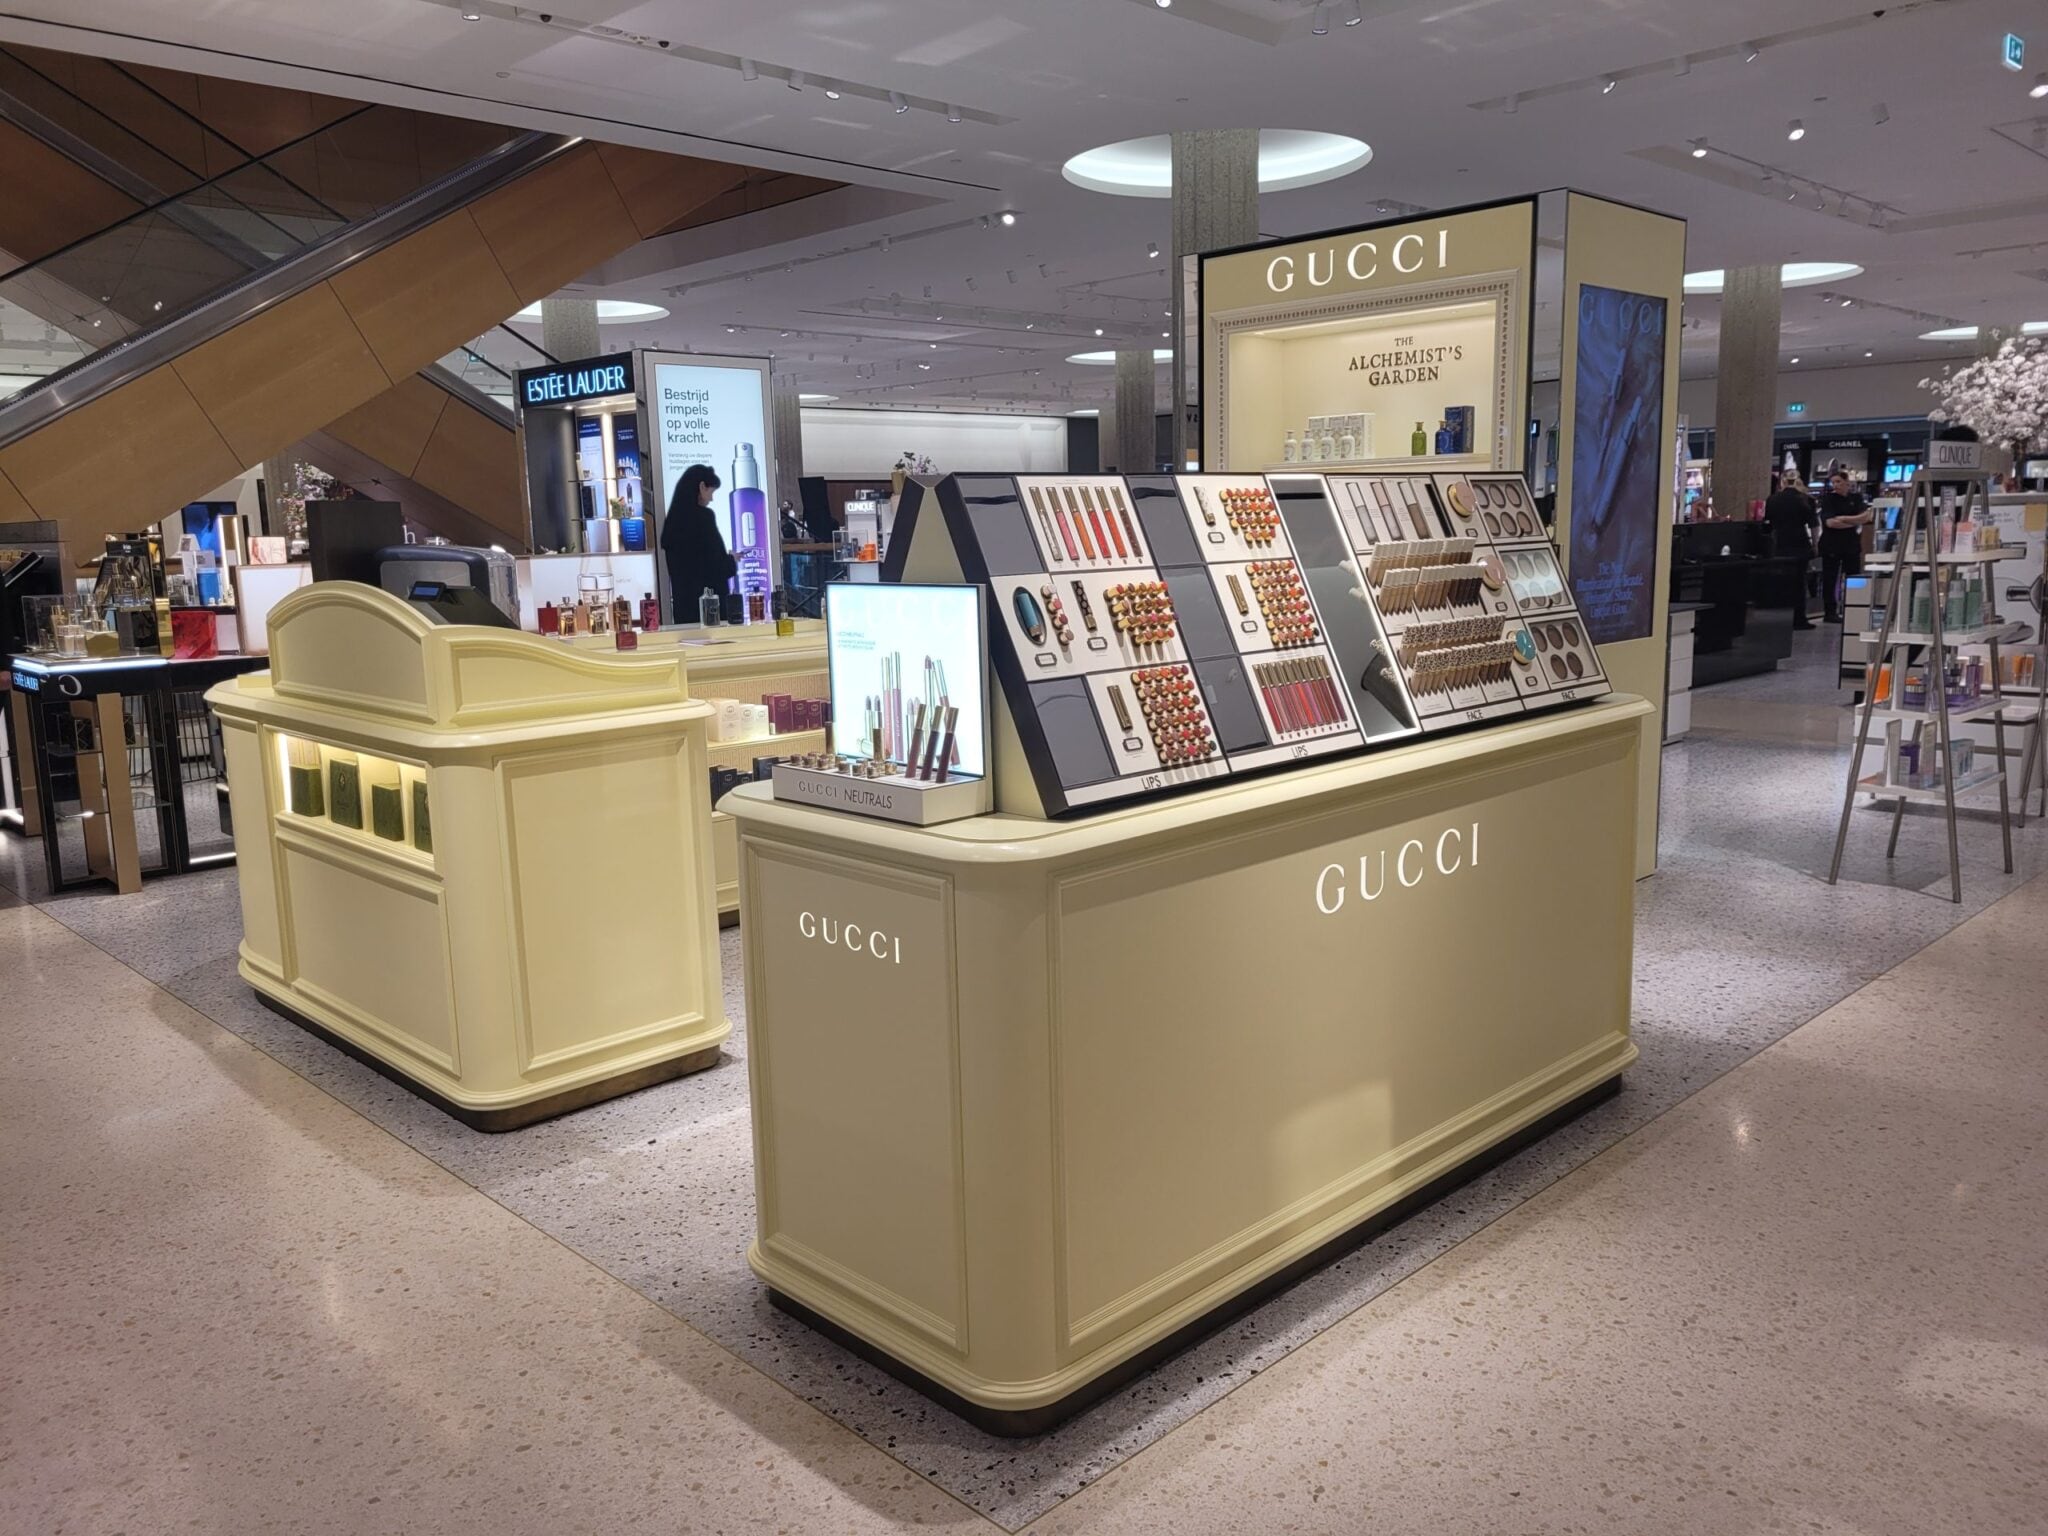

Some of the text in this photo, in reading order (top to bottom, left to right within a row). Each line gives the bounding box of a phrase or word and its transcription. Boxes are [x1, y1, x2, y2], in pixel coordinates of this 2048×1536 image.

[1266, 229, 1448, 293] GUCCI
[1394, 336, 1414, 347] THE
[1348, 345, 1463, 371] ALCHEMIST'S
[568, 366, 626, 396] LAUDER
[1368, 366, 1440, 387] GARDEN
[664, 388, 709, 403] Bestrijd
[665, 403, 709, 417] rimpels
[666, 418, 710, 431] op volle
[667, 431, 708, 444] kracht.
[1829, 440, 1862, 448] CHANEL
[1939, 445, 1972, 465] CLINIQUE
[1561, 690, 1577, 700] FACE
[1466, 709, 1483, 721] FACE
[1291, 745, 1309, 759] LIPS
[1141, 775, 1162, 791] LIPS
[798, 780, 893, 809] GUCCI NEUTRALS
[1316, 822, 1479, 915] GUCCI
[799, 911, 900, 964] GUCCI
